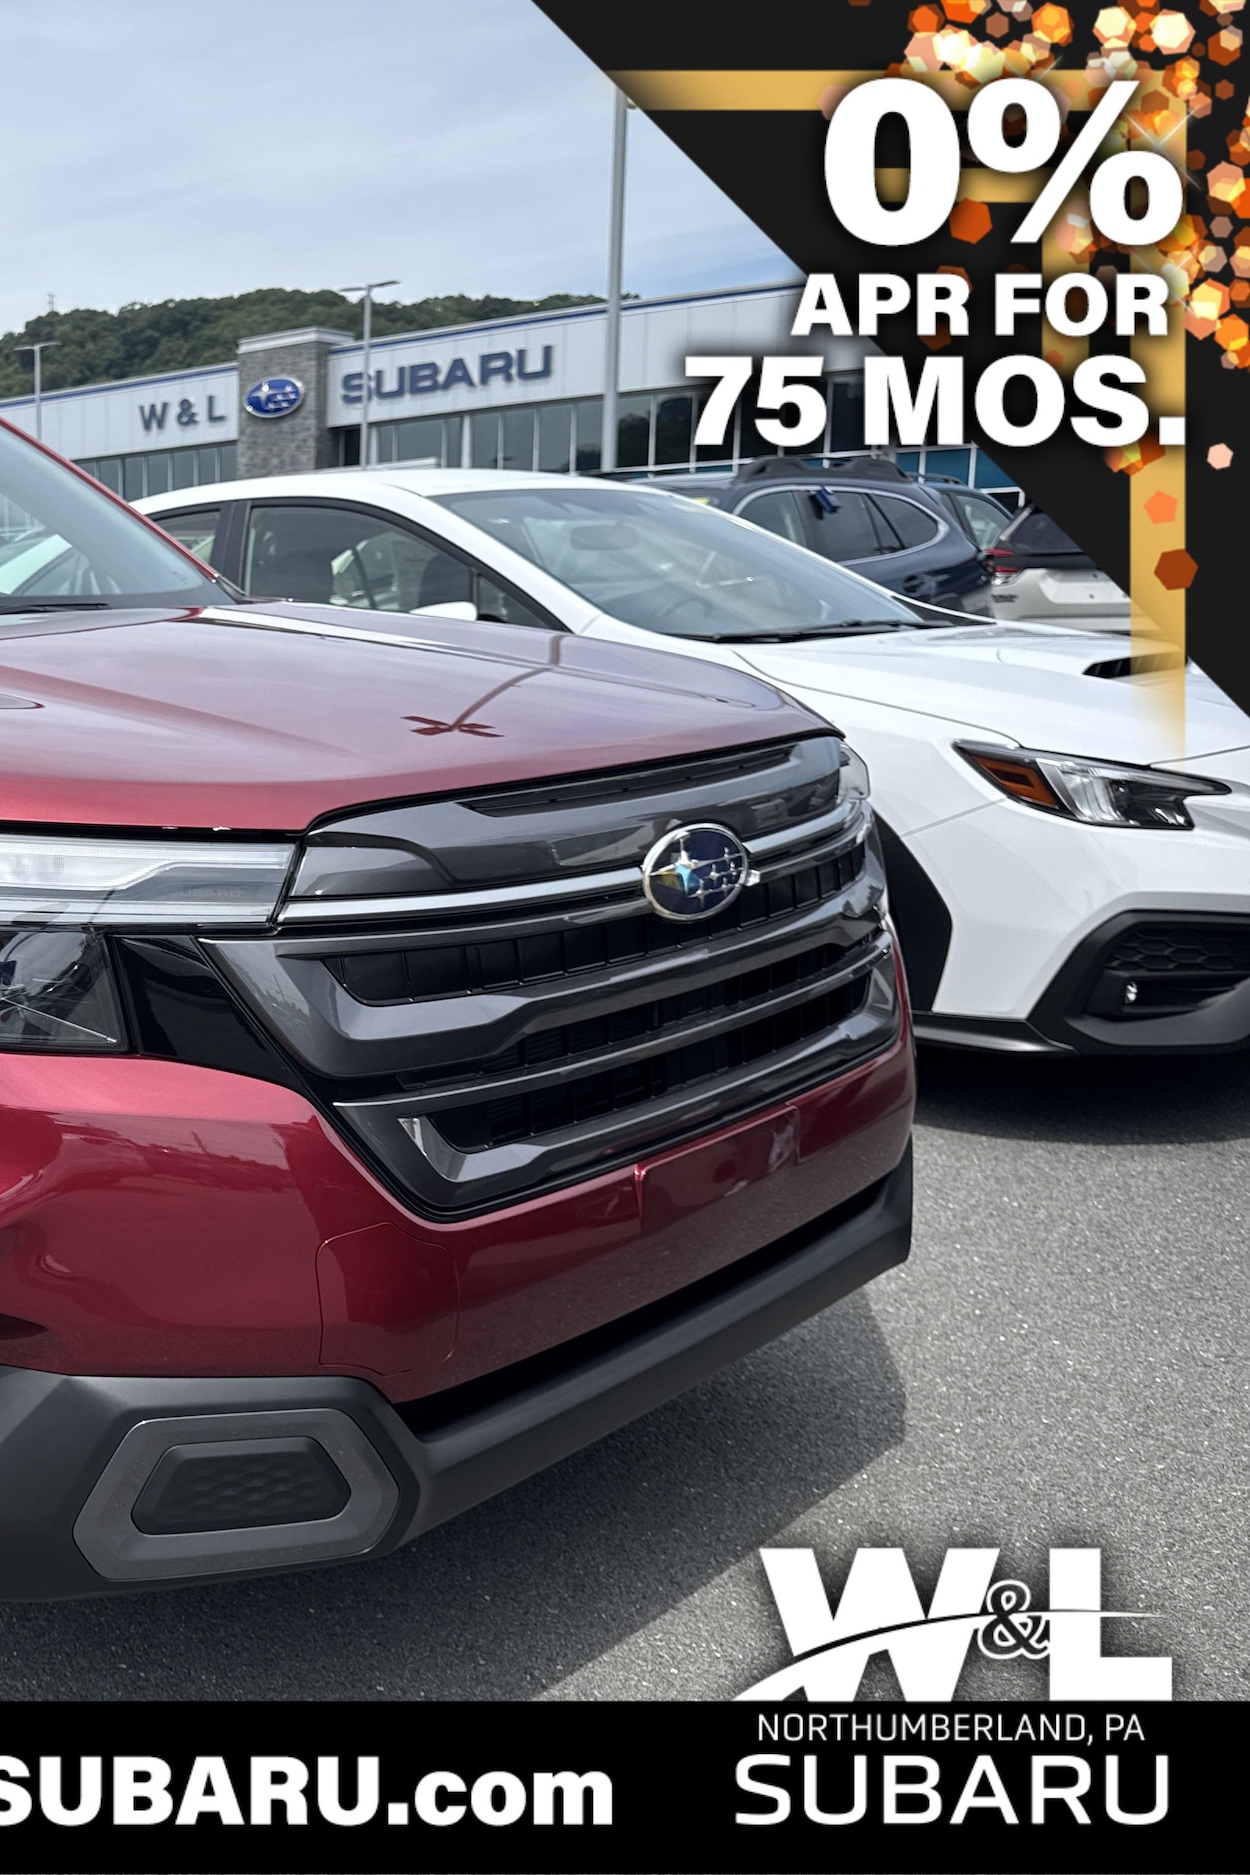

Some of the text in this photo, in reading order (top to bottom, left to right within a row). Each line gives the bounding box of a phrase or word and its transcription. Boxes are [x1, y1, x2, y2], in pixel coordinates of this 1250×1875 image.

[340, 345, 553, 405] SUBARU
[138, 395, 227, 432] W & L
